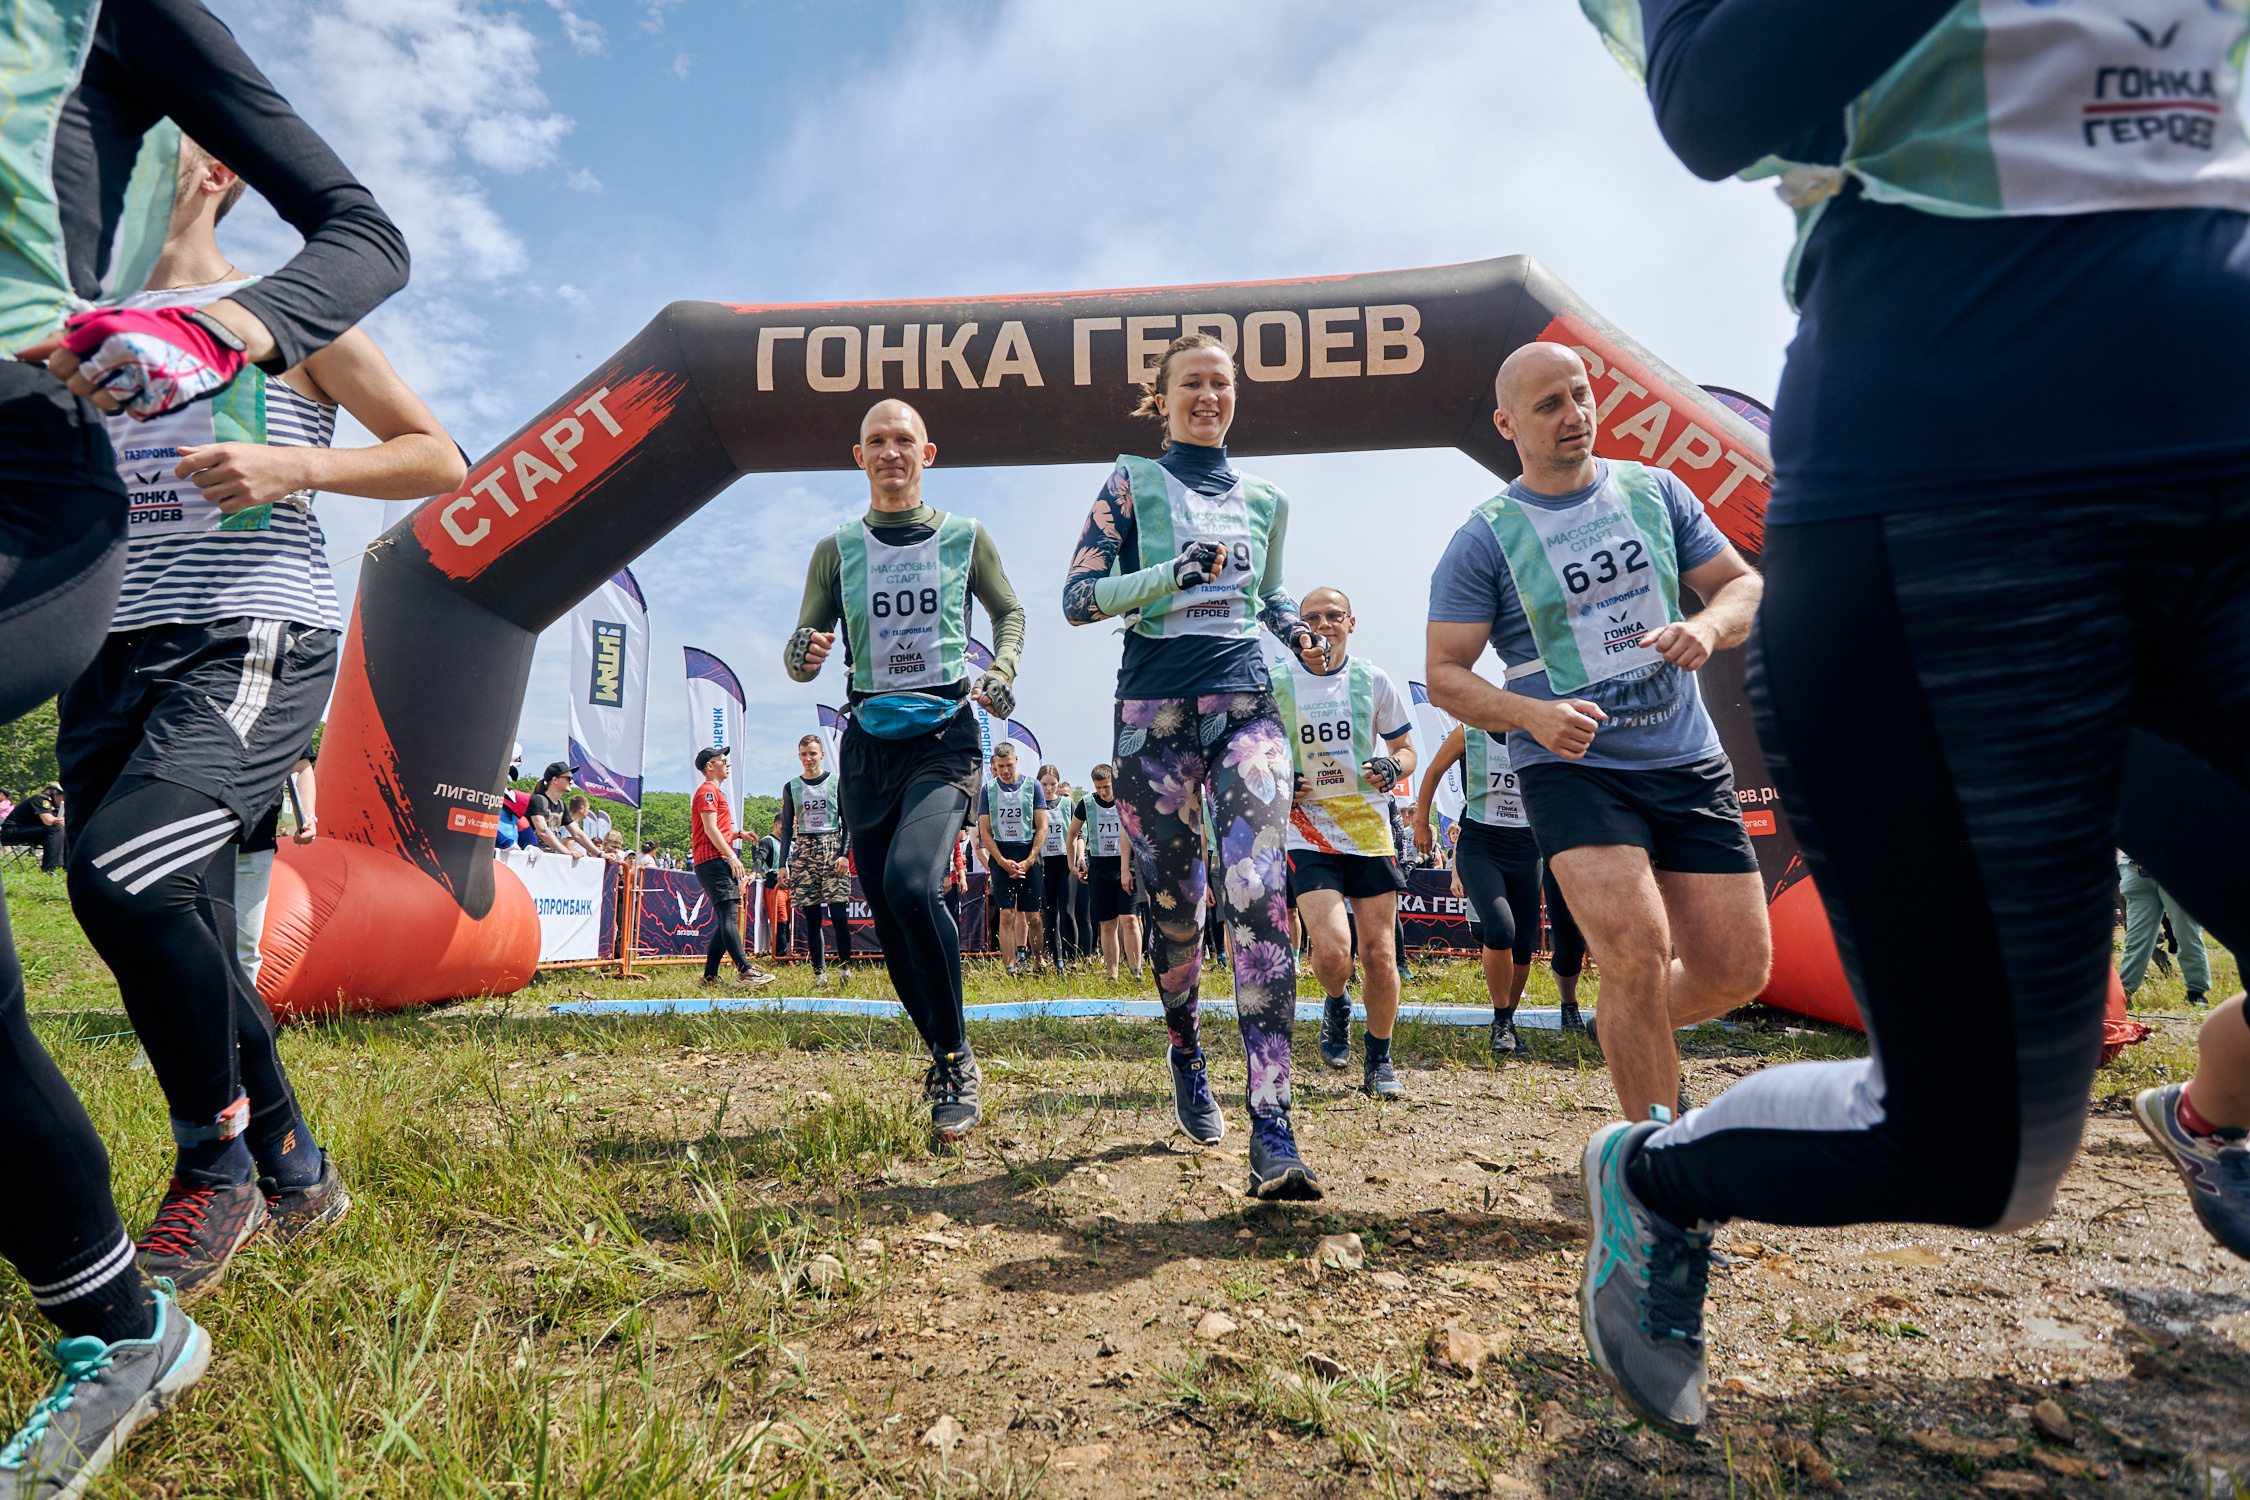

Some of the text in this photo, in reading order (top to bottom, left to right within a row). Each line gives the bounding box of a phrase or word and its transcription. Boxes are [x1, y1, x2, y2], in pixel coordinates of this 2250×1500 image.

[2095, 65, 2217, 99] ГОНКА
[757, 321, 1044, 392] ГОНКА
[439, 386, 624, 547] СТАРТ
[129, 508, 183, 524] ЕРОЕВ
[1546, 510, 1628, 549] МАССОВЫЙ
[1570, 527, 1614, 553] СТАРТ
[870, 561, 937, 575] МАССОВЫЙ
[1562, 539, 1650, 594] 632
[886, 573, 921, 584] СТАРТ
[872, 588, 938, 618] 608
[1596, 584, 1651, 610] ГАЗПРОМБАНК
[1186, 609, 1231, 618] ГЕРОЕВ
[1604, 621, 1645, 641] ГОНКА
[890, 652, 923, 663] ГОНКА
[889, 663, 926, 675] ГЕРОЕВ
[1298, 700, 1349, 712] МАССОВЫЙ
[1310, 709, 1338, 718] СТАРТ
[1301, 720, 1351, 745] 868
[1317, 769, 1342, 777] ГОНКА
[1316, 777, 1345, 787] ГЕРОЕВ
[1490, 772, 1516, 789] 76
[804, 799, 826, 810] 623
[999, 807, 1022, 818] 723
[1048, 824, 1062, 834] 12
[1098, 822, 1119, 833] 711
